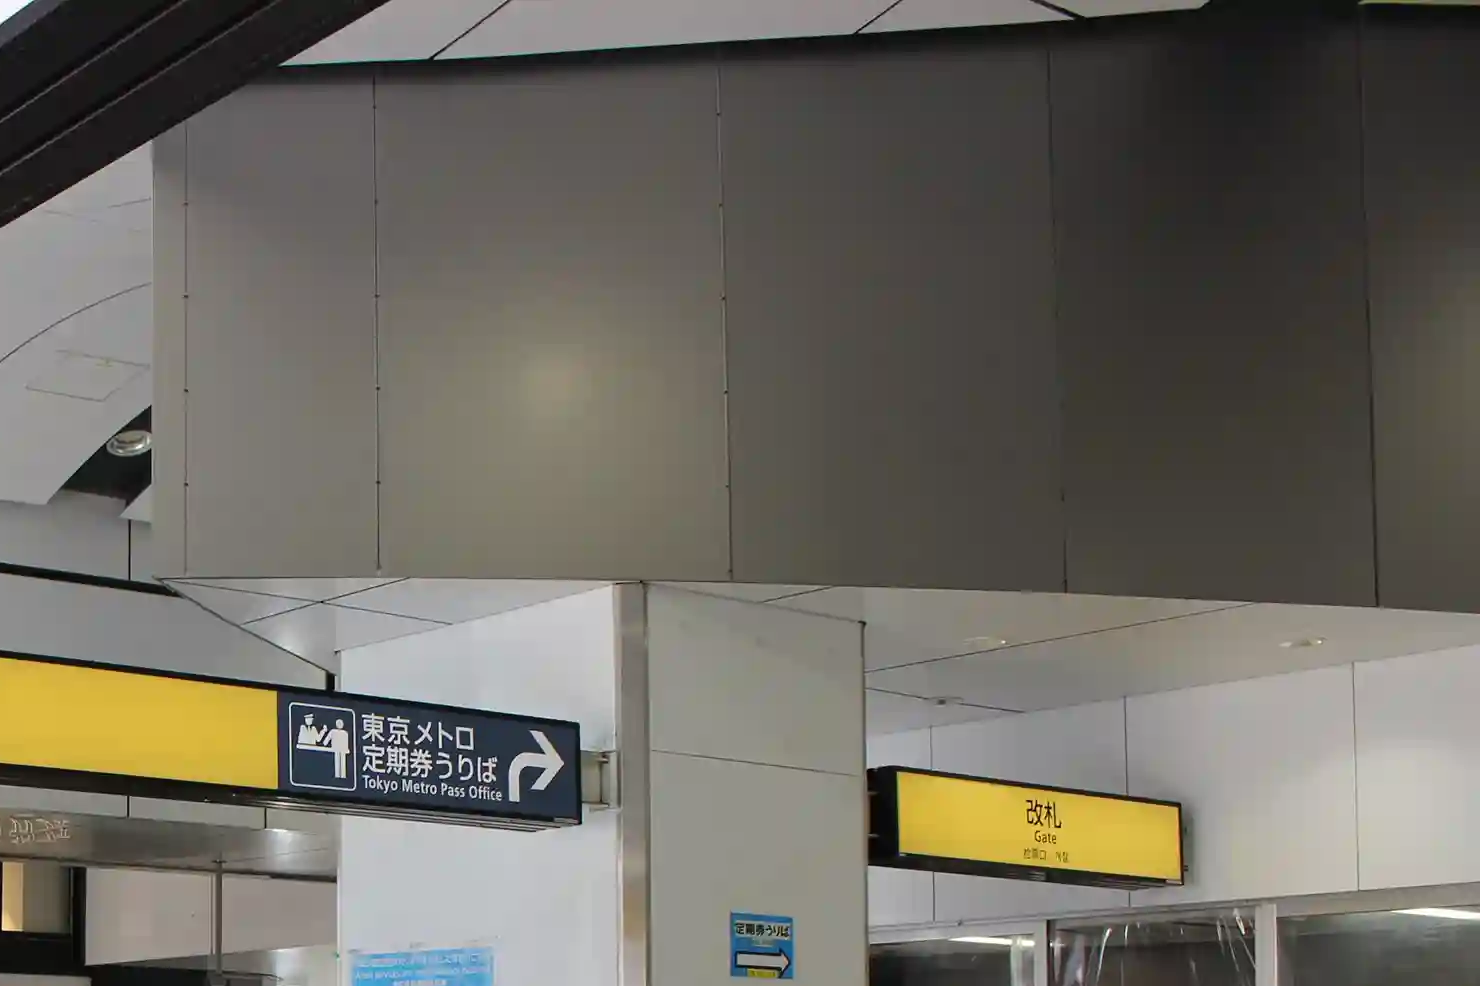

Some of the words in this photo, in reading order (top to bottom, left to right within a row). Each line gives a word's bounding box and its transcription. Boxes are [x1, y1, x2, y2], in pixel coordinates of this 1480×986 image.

[361, 713, 474, 751] 東京メトロ
[362, 744, 498, 783] 定期券うりば
[362, 774, 398, 794] Tokyo
[402, 779, 437, 795] Metro
[441, 783, 466, 798] Pass
[469, 786, 503, 801] Office
[1025, 799, 1063, 828] 改札
[1034, 830, 1057, 844] Gate
